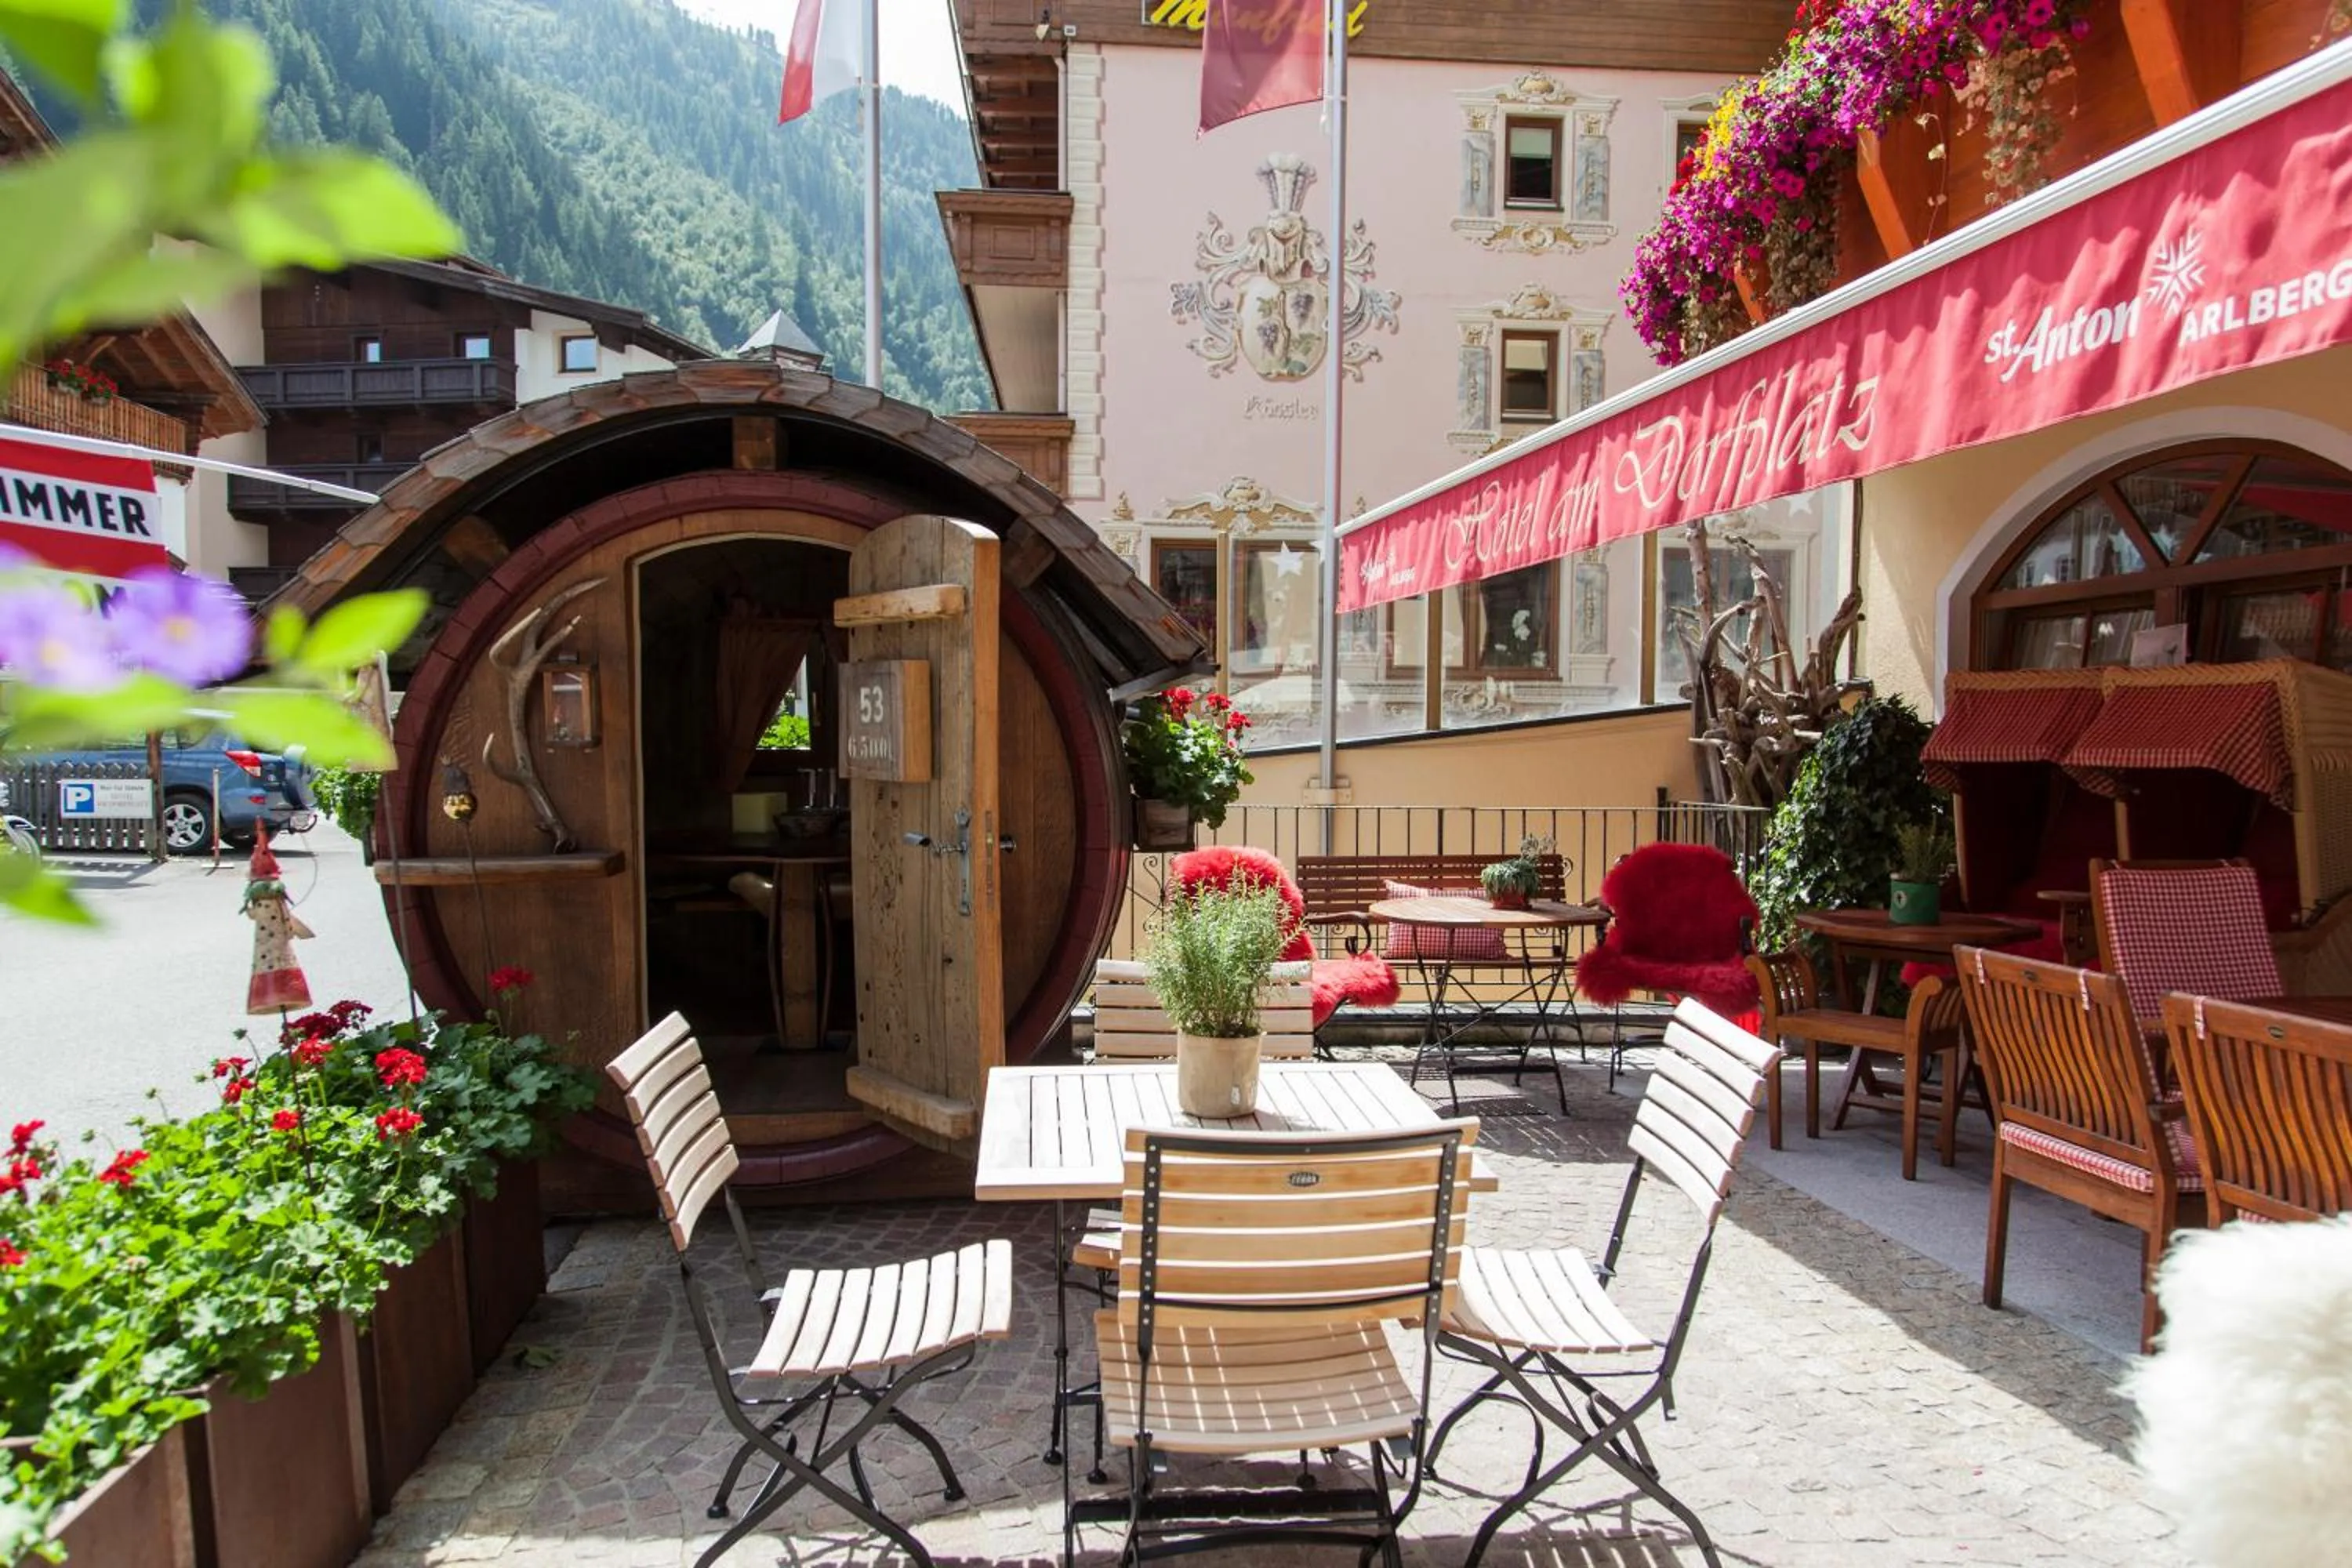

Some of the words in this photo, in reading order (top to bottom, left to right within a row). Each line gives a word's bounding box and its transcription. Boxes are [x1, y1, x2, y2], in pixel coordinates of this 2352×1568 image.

[2179, 259, 2352, 348] ARLBERG
[1444, 469, 1548, 569] Hotel
[1547, 476, 1600, 542] am
[1613, 363, 1879, 513] Dorfplatz
[860, 685, 884, 723] 53
[67, 786, 92, 811] P
